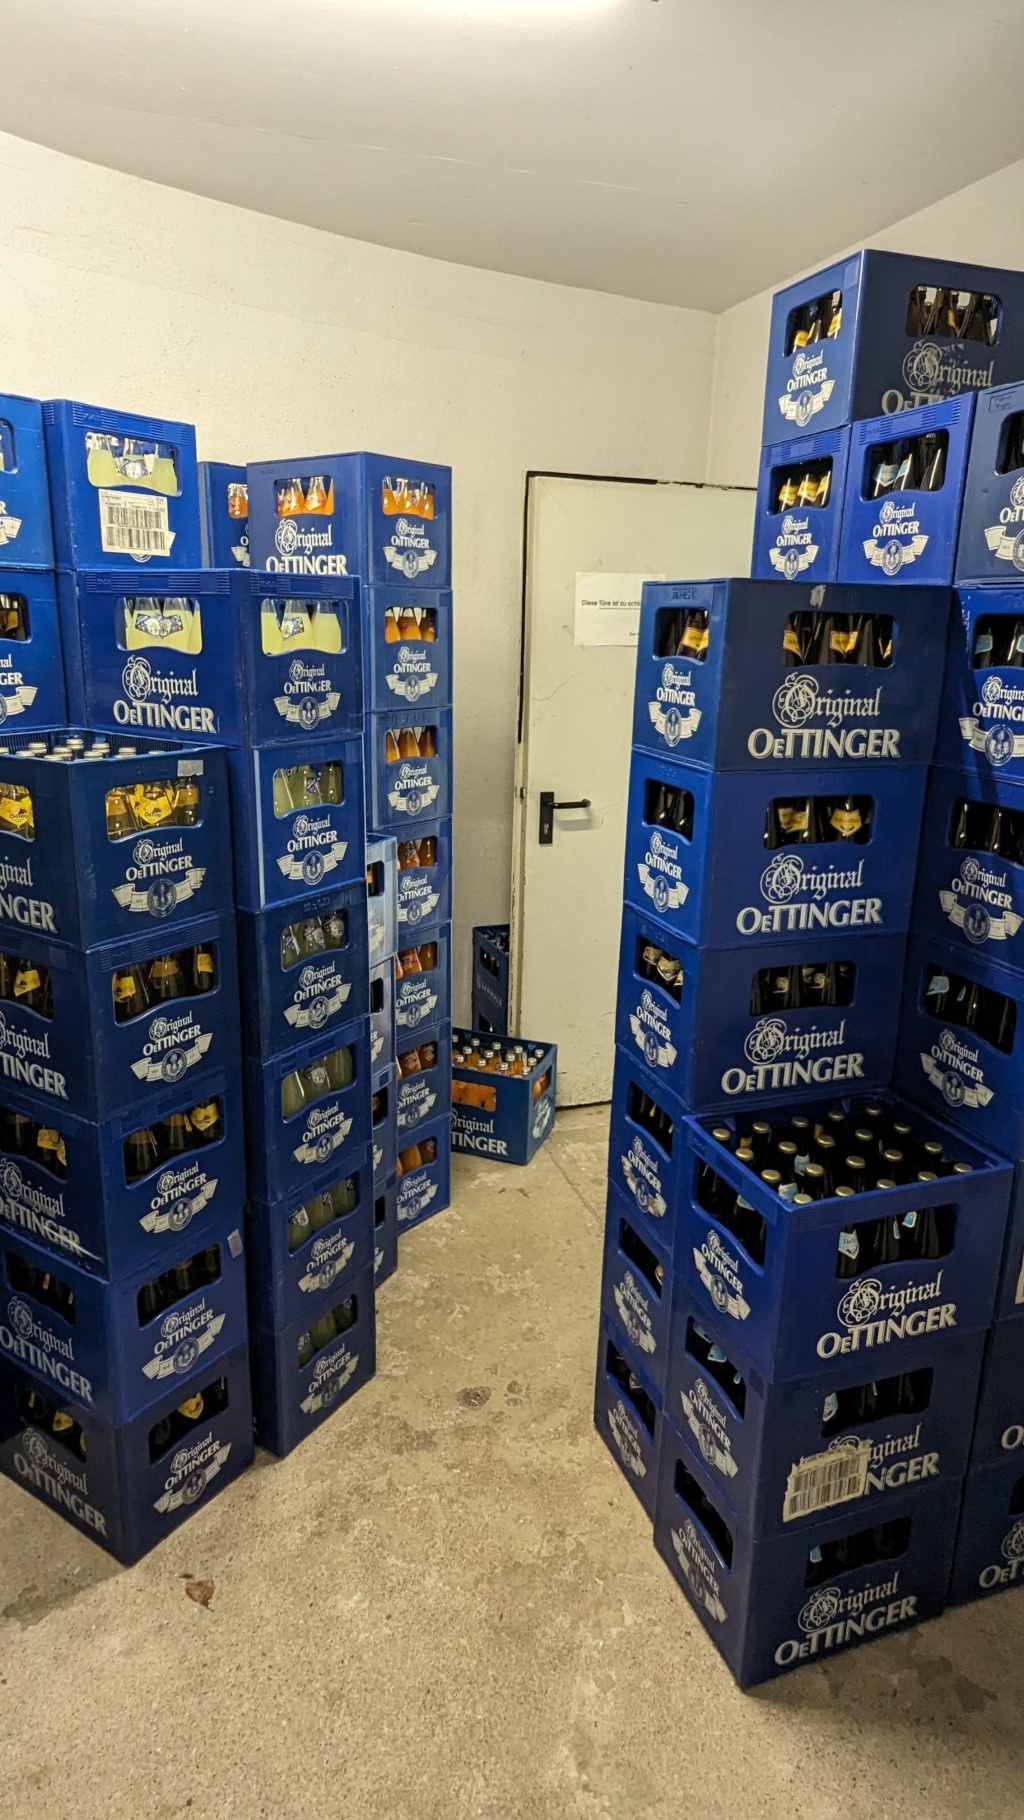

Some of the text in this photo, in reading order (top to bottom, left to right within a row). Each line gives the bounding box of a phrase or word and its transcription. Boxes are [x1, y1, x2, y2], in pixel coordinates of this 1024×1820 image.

[792, 350, 823, 378] Original
[902, 340, 995, 394] Original
[396, 518, 425, 537] Original
[782, 514, 808, 534] Original
[880, 501, 914, 526] Original
[276, 518, 333, 556] Original
[398, 646, 426, 663] Original
[122, 656, 198, 702] Original
[290, 660, 325, 682] Original
[662, 662, 691, 690] Original
[772, 672, 882, 728] Original
[400, 763, 428, 781] Original
[292, 814, 330, 838] Original
[133, 838, 183, 866] Original
[651, 832, 678, 860] Original
[760, 853, 864, 904] Original
[961, 856, 1006, 888] Original
[300, 960, 335, 989] Original
[149, 1010, 193, 1042] Original
[744, 1018, 846, 1065] Original
[939, 1029, 980, 1062] Original
[307, 1102, 340, 1129] Original
[0, 1158, 66, 1218] Original
[157, 1162, 199, 1194] Original
[0, 1197, 83, 1258] ETTINGER
[706, 1230, 739, 1274] Original
[838, 1270, 943, 1328] Original
[8, 1296, 74, 1360] Original
[161, 1298, 206, 1338] Original
[22, 1428, 88, 1496] Original
[170, 1431, 212, 1473] Original
[798, 1570, 900, 1632] Original
